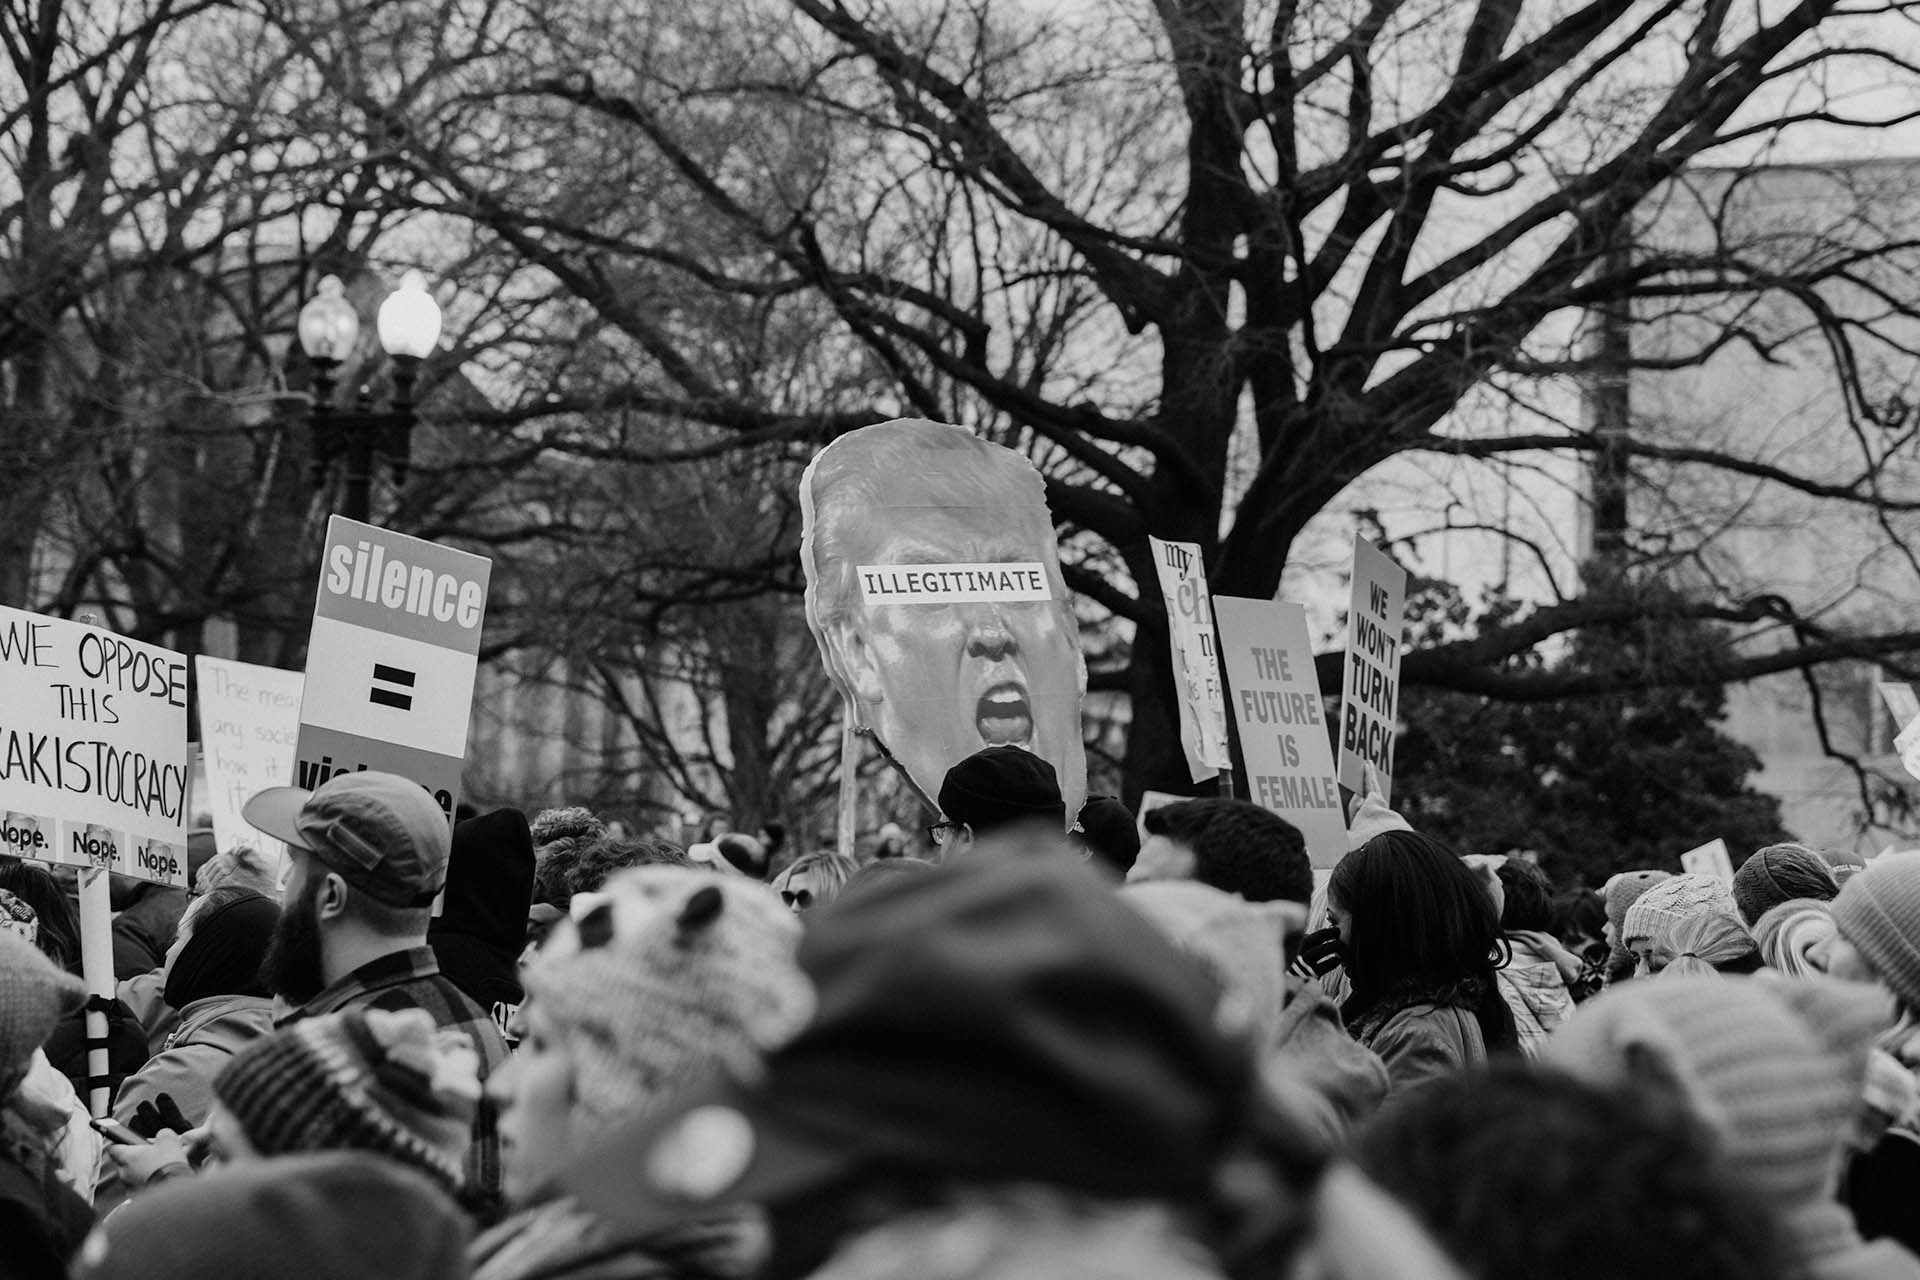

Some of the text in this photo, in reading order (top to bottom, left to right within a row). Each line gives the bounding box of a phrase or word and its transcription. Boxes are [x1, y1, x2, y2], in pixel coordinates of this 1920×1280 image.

[326, 541, 482, 629] silence
[864, 570, 1043, 595] ILLEGITIMATE
[1370, 580, 1389, 620] WE
[0, 620, 186, 708] WE OPPOSE
[1251, 647, 1293, 681] THE
[50, 684, 120, 724] THIS
[209, 666, 299, 707] The mea
[1352, 652, 1394, 721] TURN
[1240, 690, 1320, 726] FUTURE
[1277, 734, 1300, 769] IS
[1344, 702, 1393, 776] BACK
[0, 727, 187, 827] AKISTOCRACY
[1256, 775, 1338, 809] FEMALE
[73, 831, 121, 863] Nope.
[138, 846, 182, 877] Nope.
